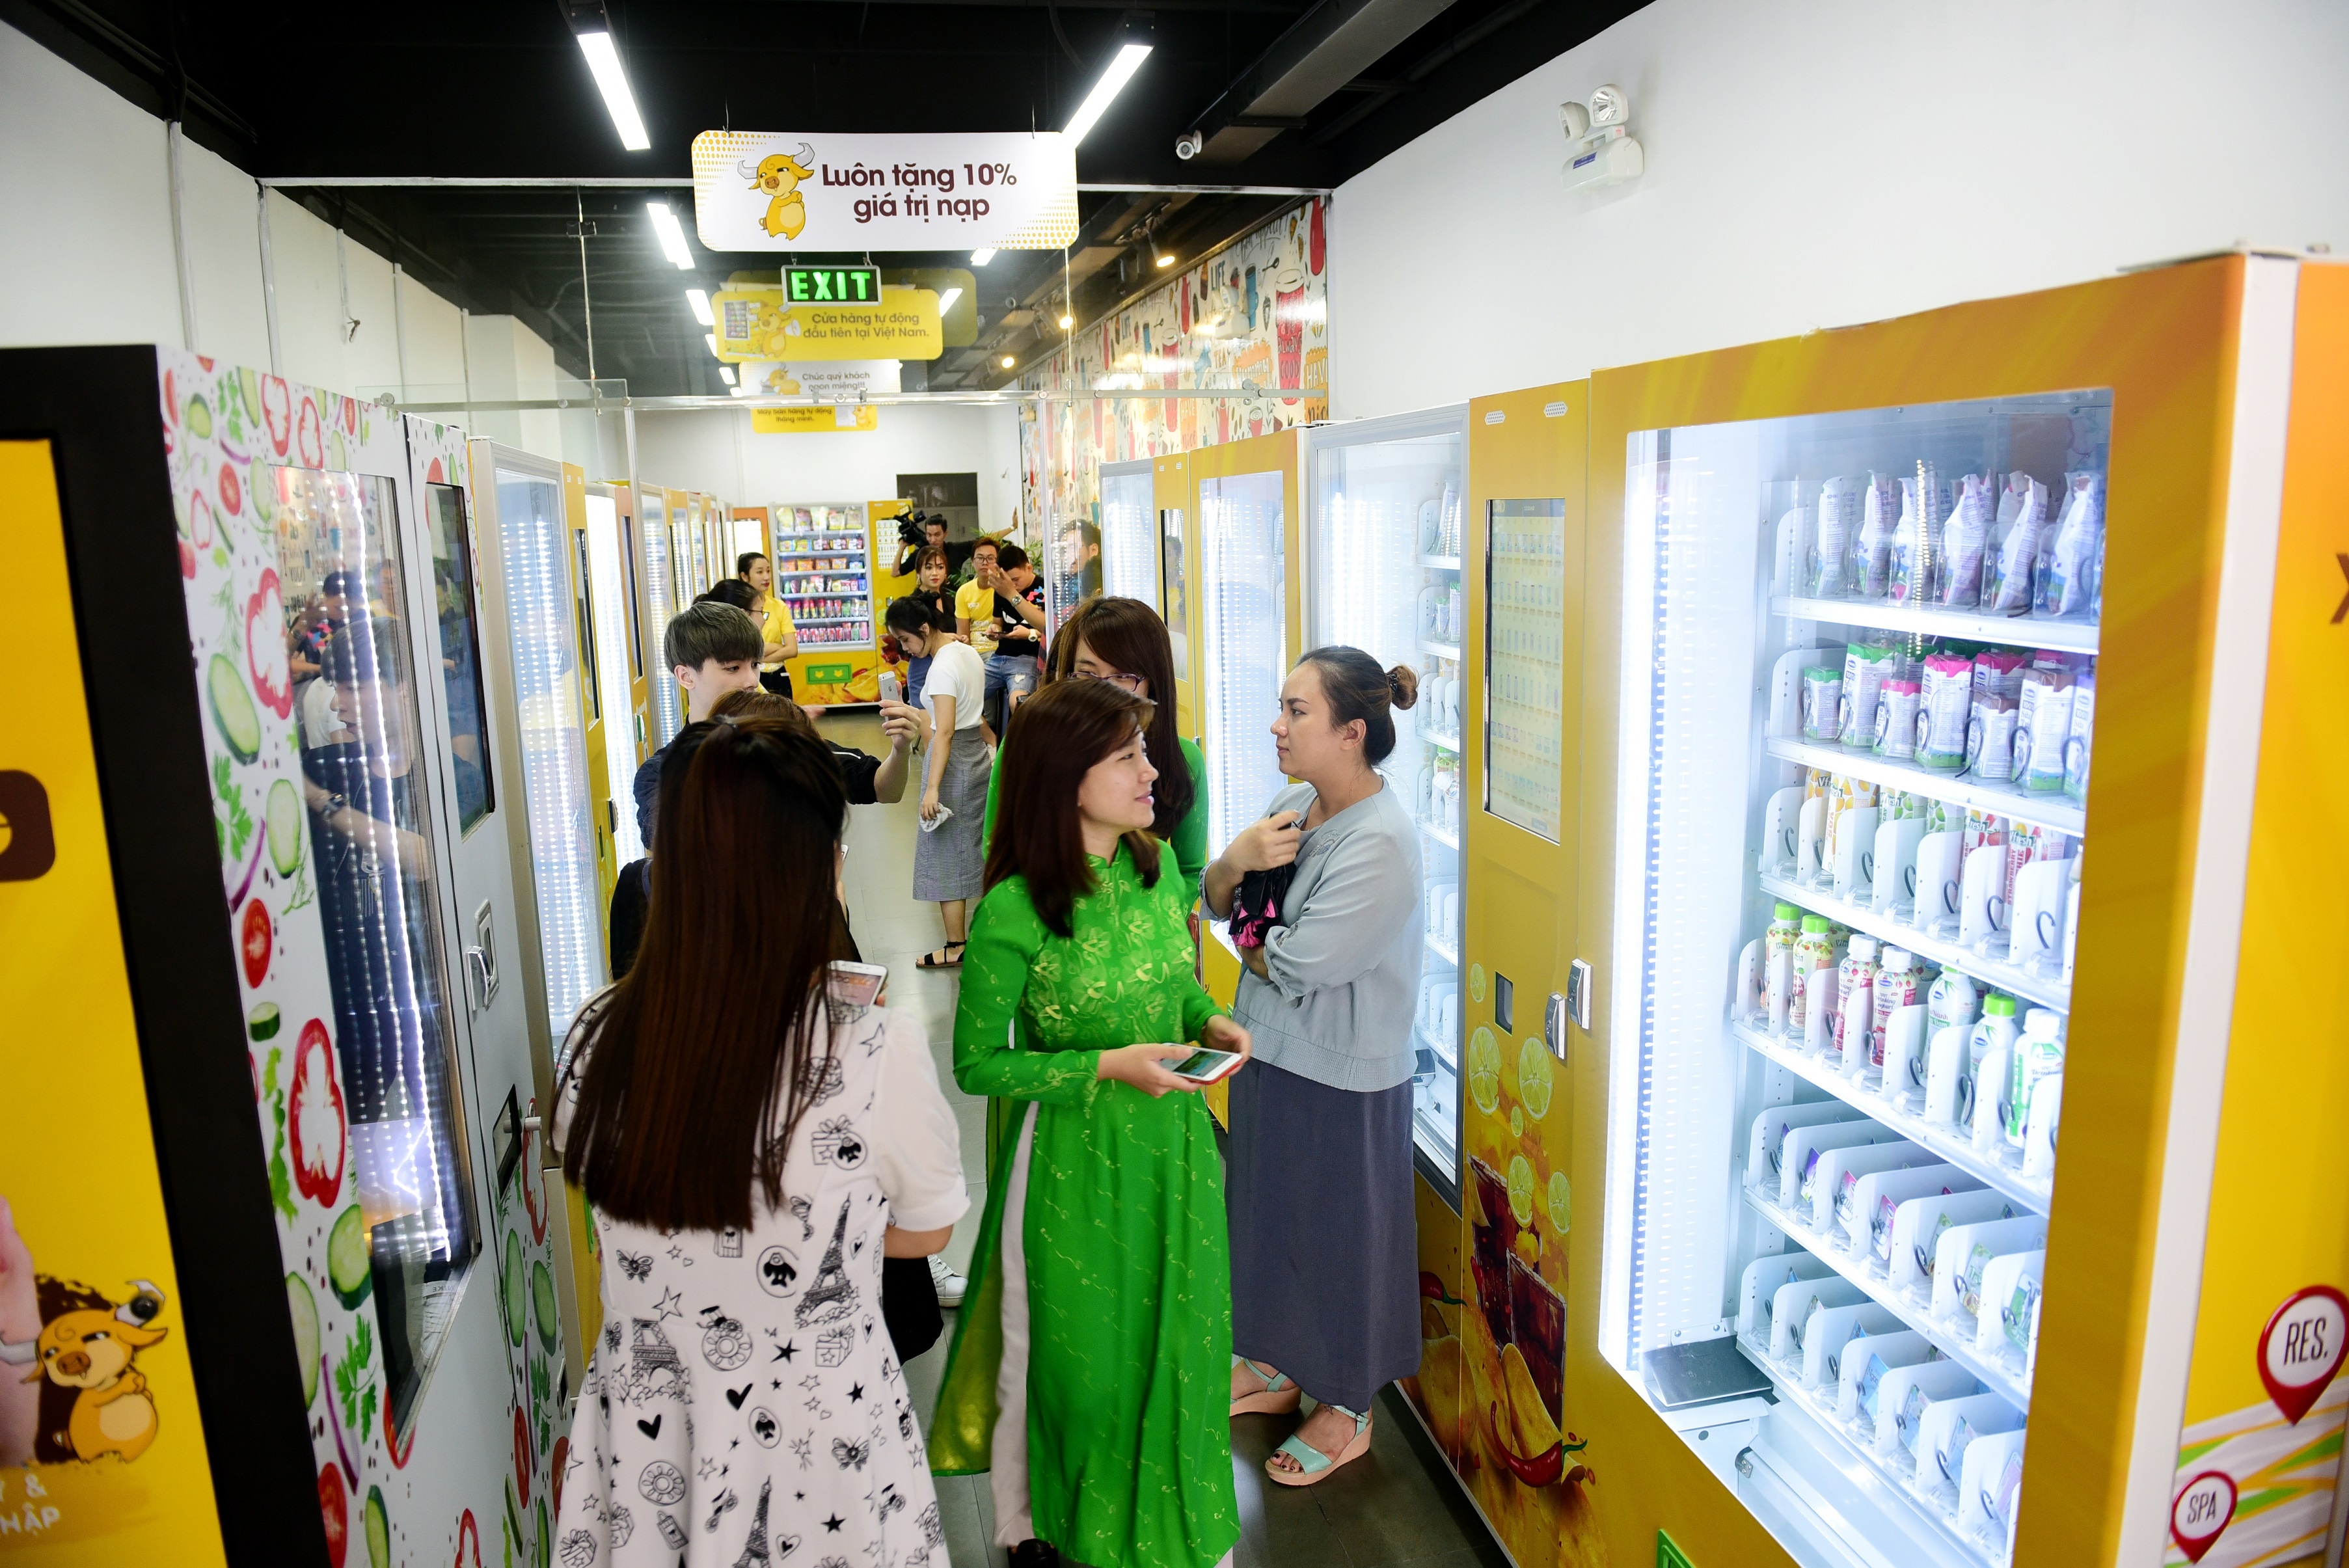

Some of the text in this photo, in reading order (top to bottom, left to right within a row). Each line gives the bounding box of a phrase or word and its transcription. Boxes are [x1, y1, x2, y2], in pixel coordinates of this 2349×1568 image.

[822, 162, 1017, 193] Luôn tặng 10%
[854, 192, 990, 223] giá trị nạp
[791, 272, 871, 300] EXIT
[811, 312, 919, 326] Cửa hàng tự động
[830, 327, 852, 338] tiên
[855, 327, 870, 340] tại
[873, 326, 895, 340] Việt
[899, 327, 929, 336] Nam.
[802, 371, 870, 381] Chúc quý khách
[2007, 849, 2016, 905] STRAWBERRY
[2284, 1316, 2328, 1366] RES.
[2187, 1490, 2217, 1524] SPA
